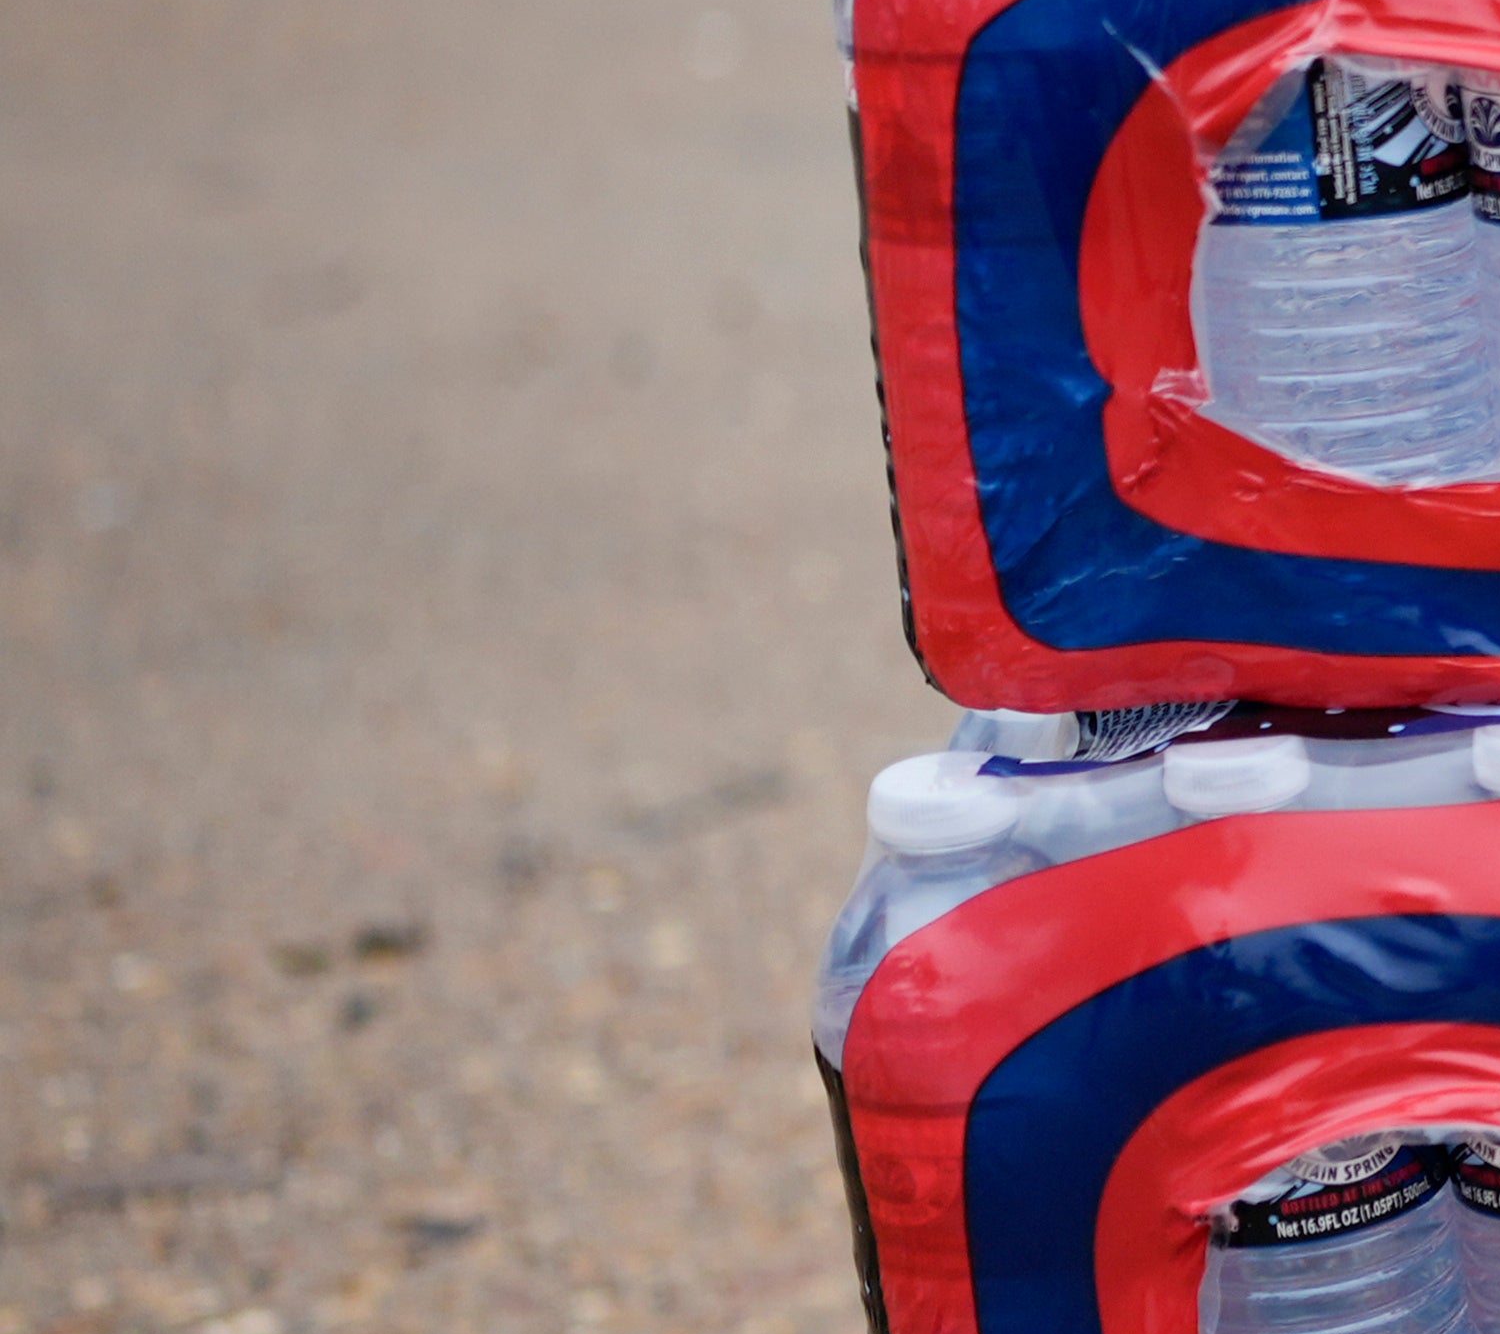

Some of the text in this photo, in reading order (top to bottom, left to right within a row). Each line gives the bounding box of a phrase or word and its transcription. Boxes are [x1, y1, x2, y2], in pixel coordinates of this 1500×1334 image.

[1343, 1145, 1394, 1181] SPRING
[1276, 1221, 1299, 1238] Net
[1301, 1211, 1341, 1236] 16.9FL
[1341, 1207, 1360, 1227] OZ
